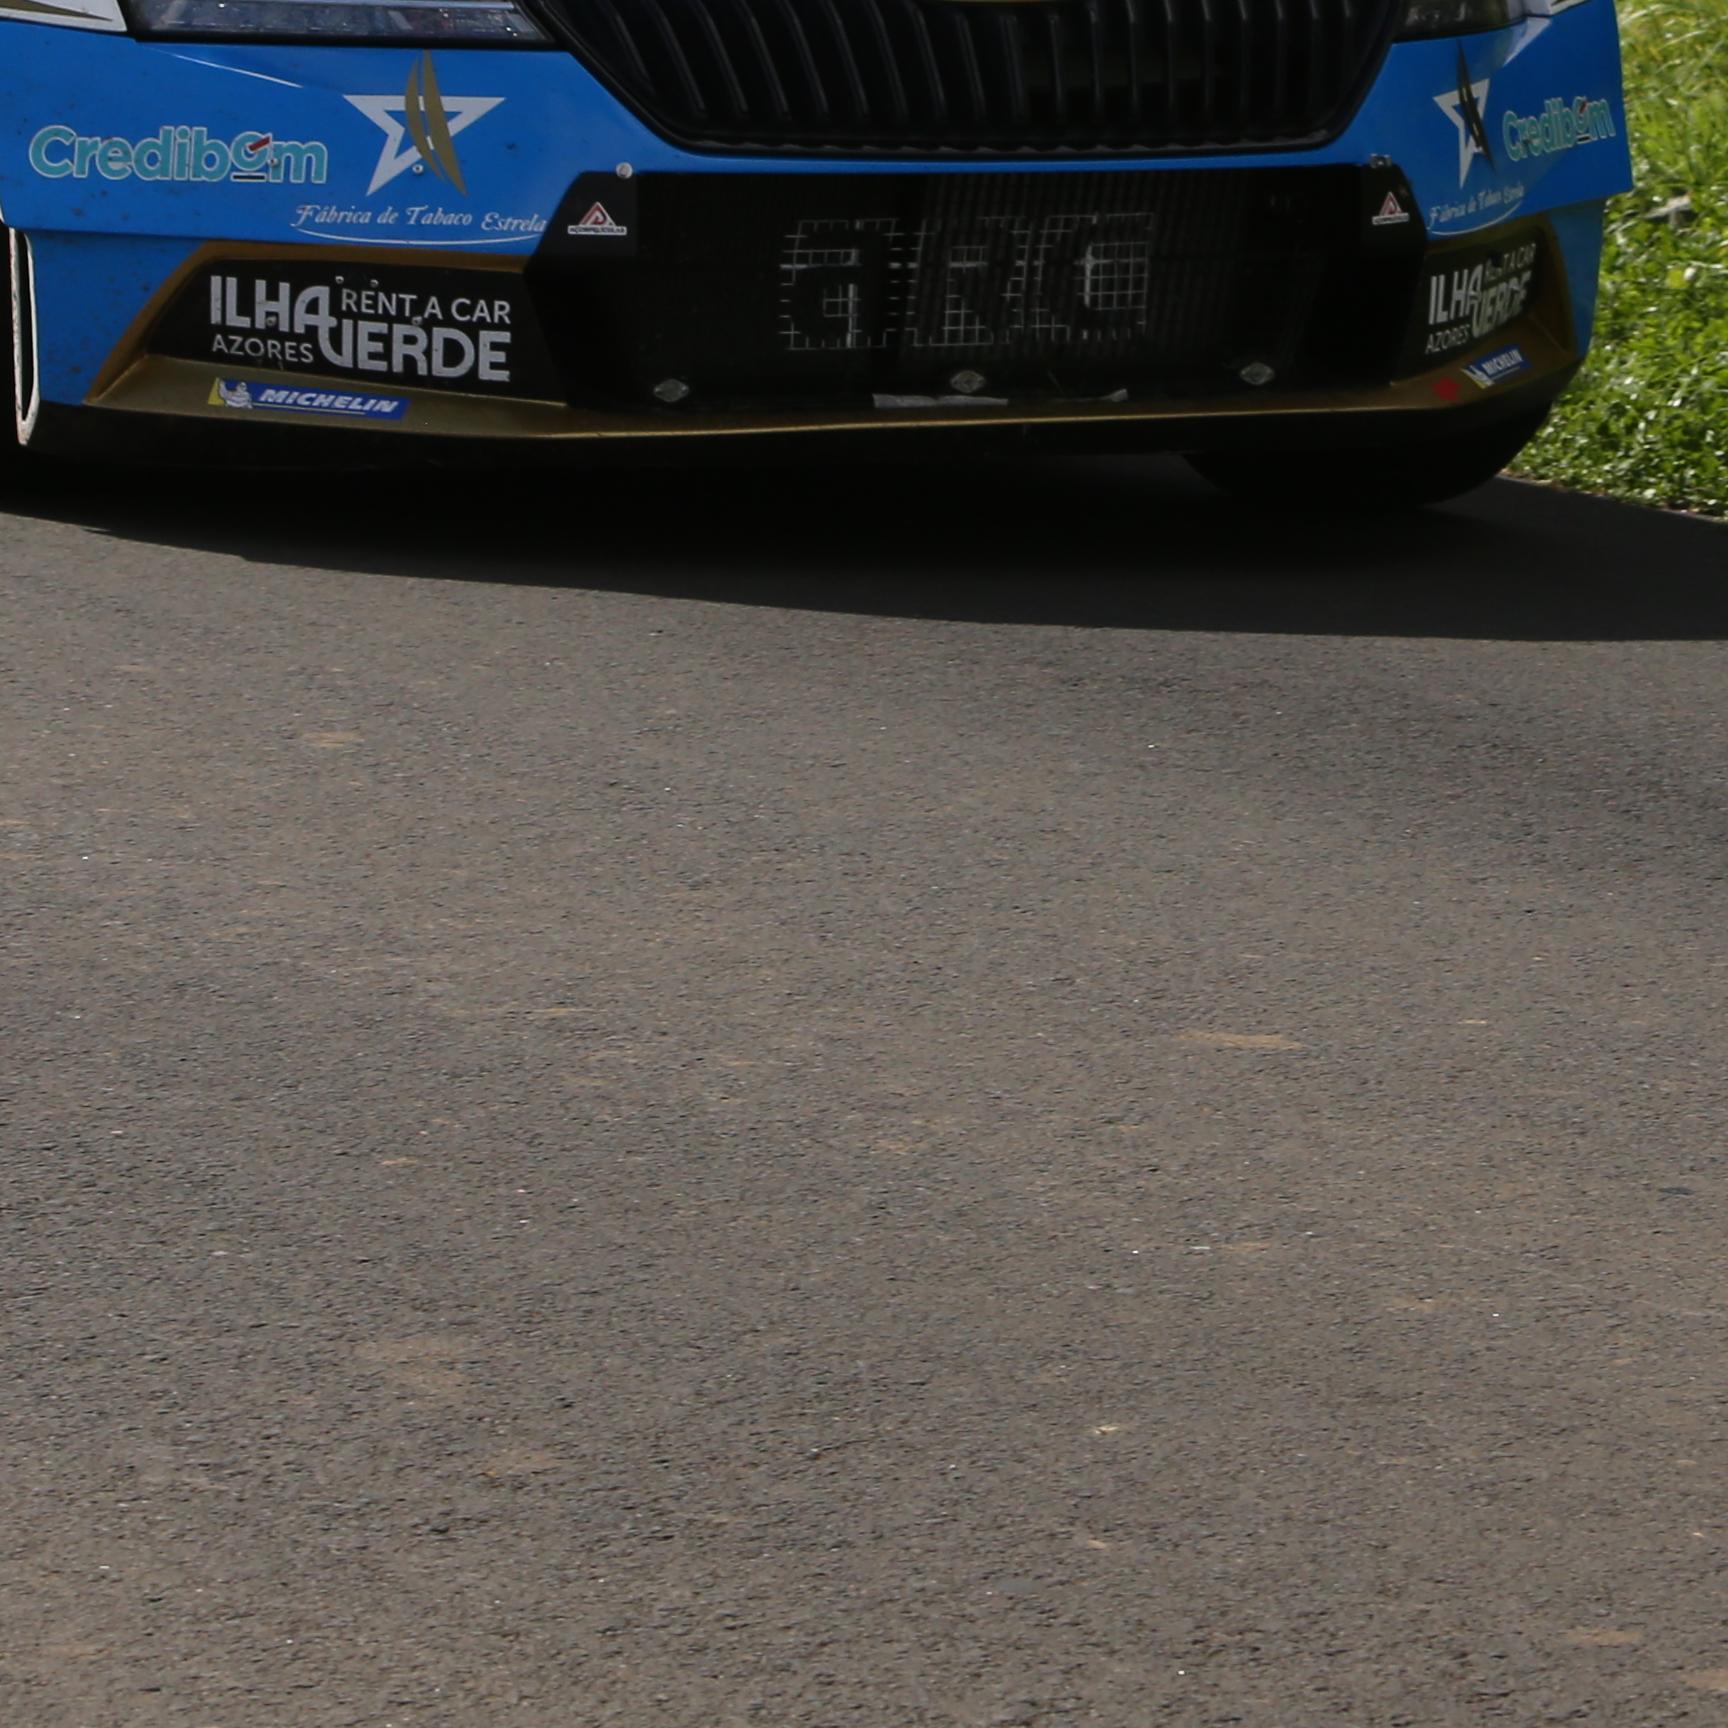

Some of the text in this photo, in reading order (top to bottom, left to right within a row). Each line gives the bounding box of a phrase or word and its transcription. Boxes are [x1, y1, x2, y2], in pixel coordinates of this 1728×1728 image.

[1503, 96, 1617, 162] Credibom
[28, 125, 329, 184] Credibom
[292, 204, 549, 234] Fábrica de Tabaco Estrela
[210, 275, 332, 336] ILHA
[341, 288, 512, 325] RENT A CAR
[212, 334, 315, 364] AZORES
[1425, 323, 1471, 355] AZORES
[1482, 348, 1524, 376] MICHELIN
[259, 389, 399, 414] MICHELIN
